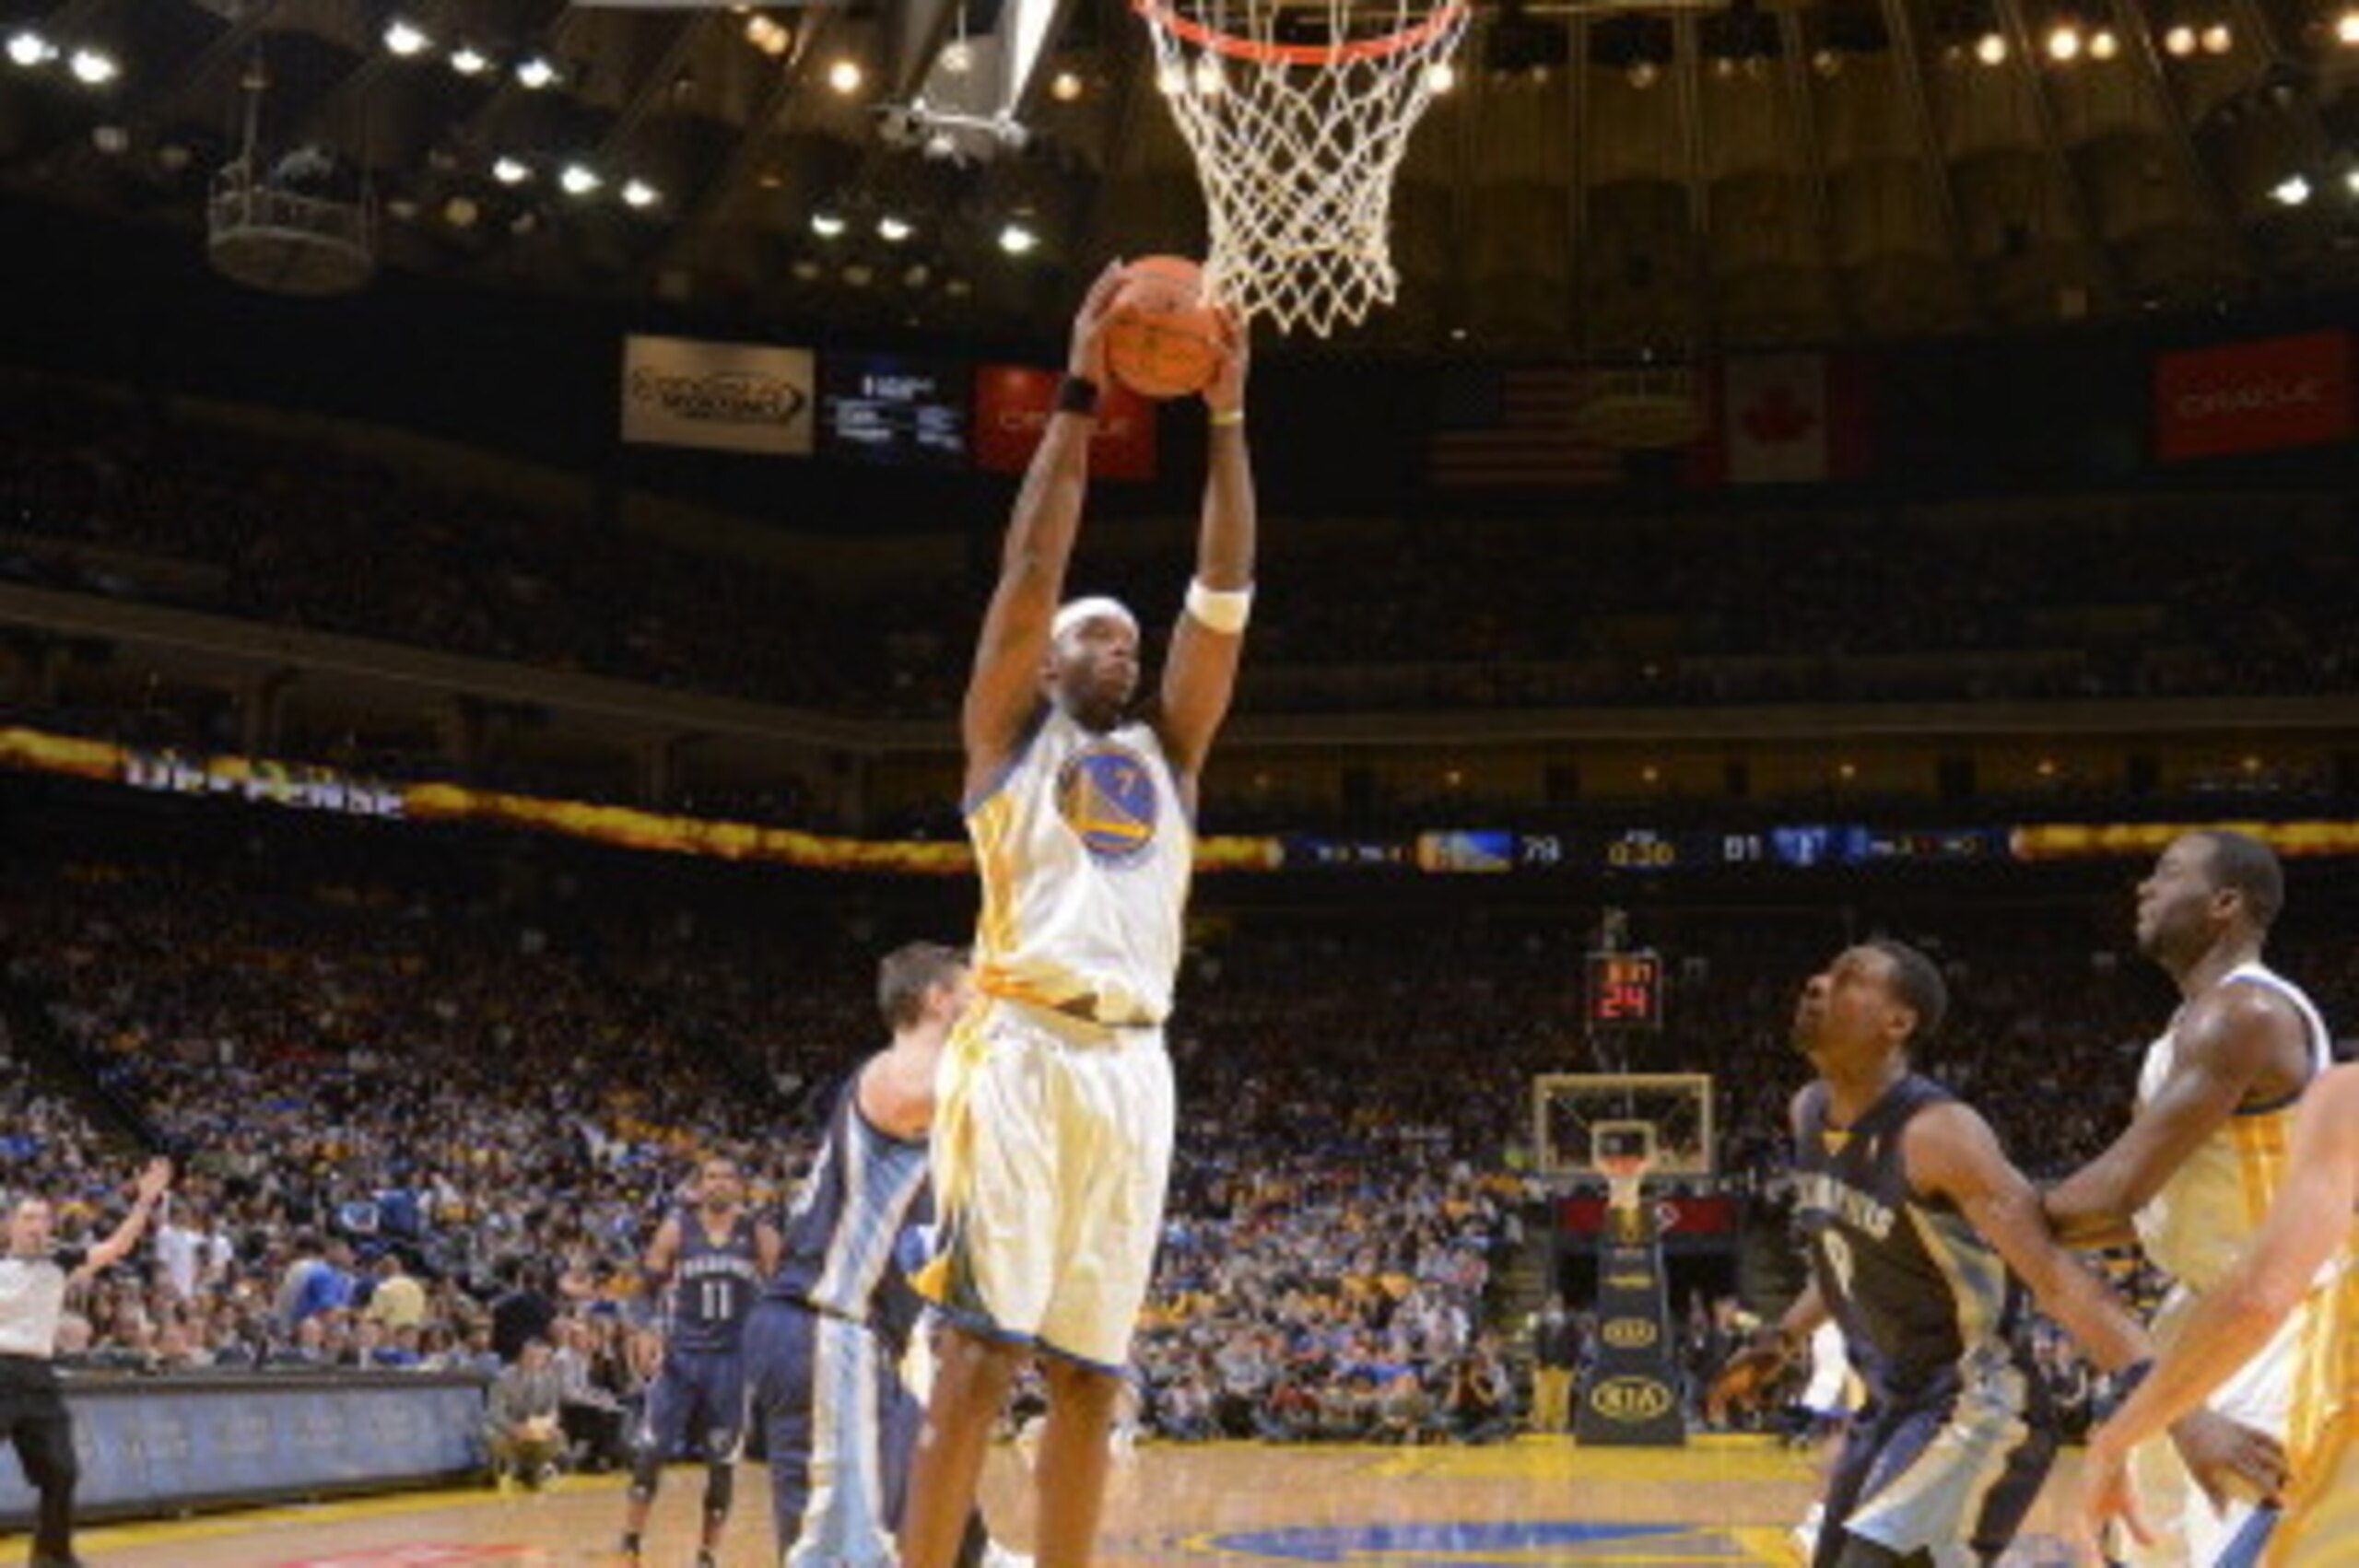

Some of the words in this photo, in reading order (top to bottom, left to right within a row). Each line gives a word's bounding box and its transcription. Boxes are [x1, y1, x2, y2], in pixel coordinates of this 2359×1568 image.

[1599, 985, 1647, 1018] 24
[701, 1280, 731, 1320] 11
[1602, 1385, 1659, 1413] KIA
